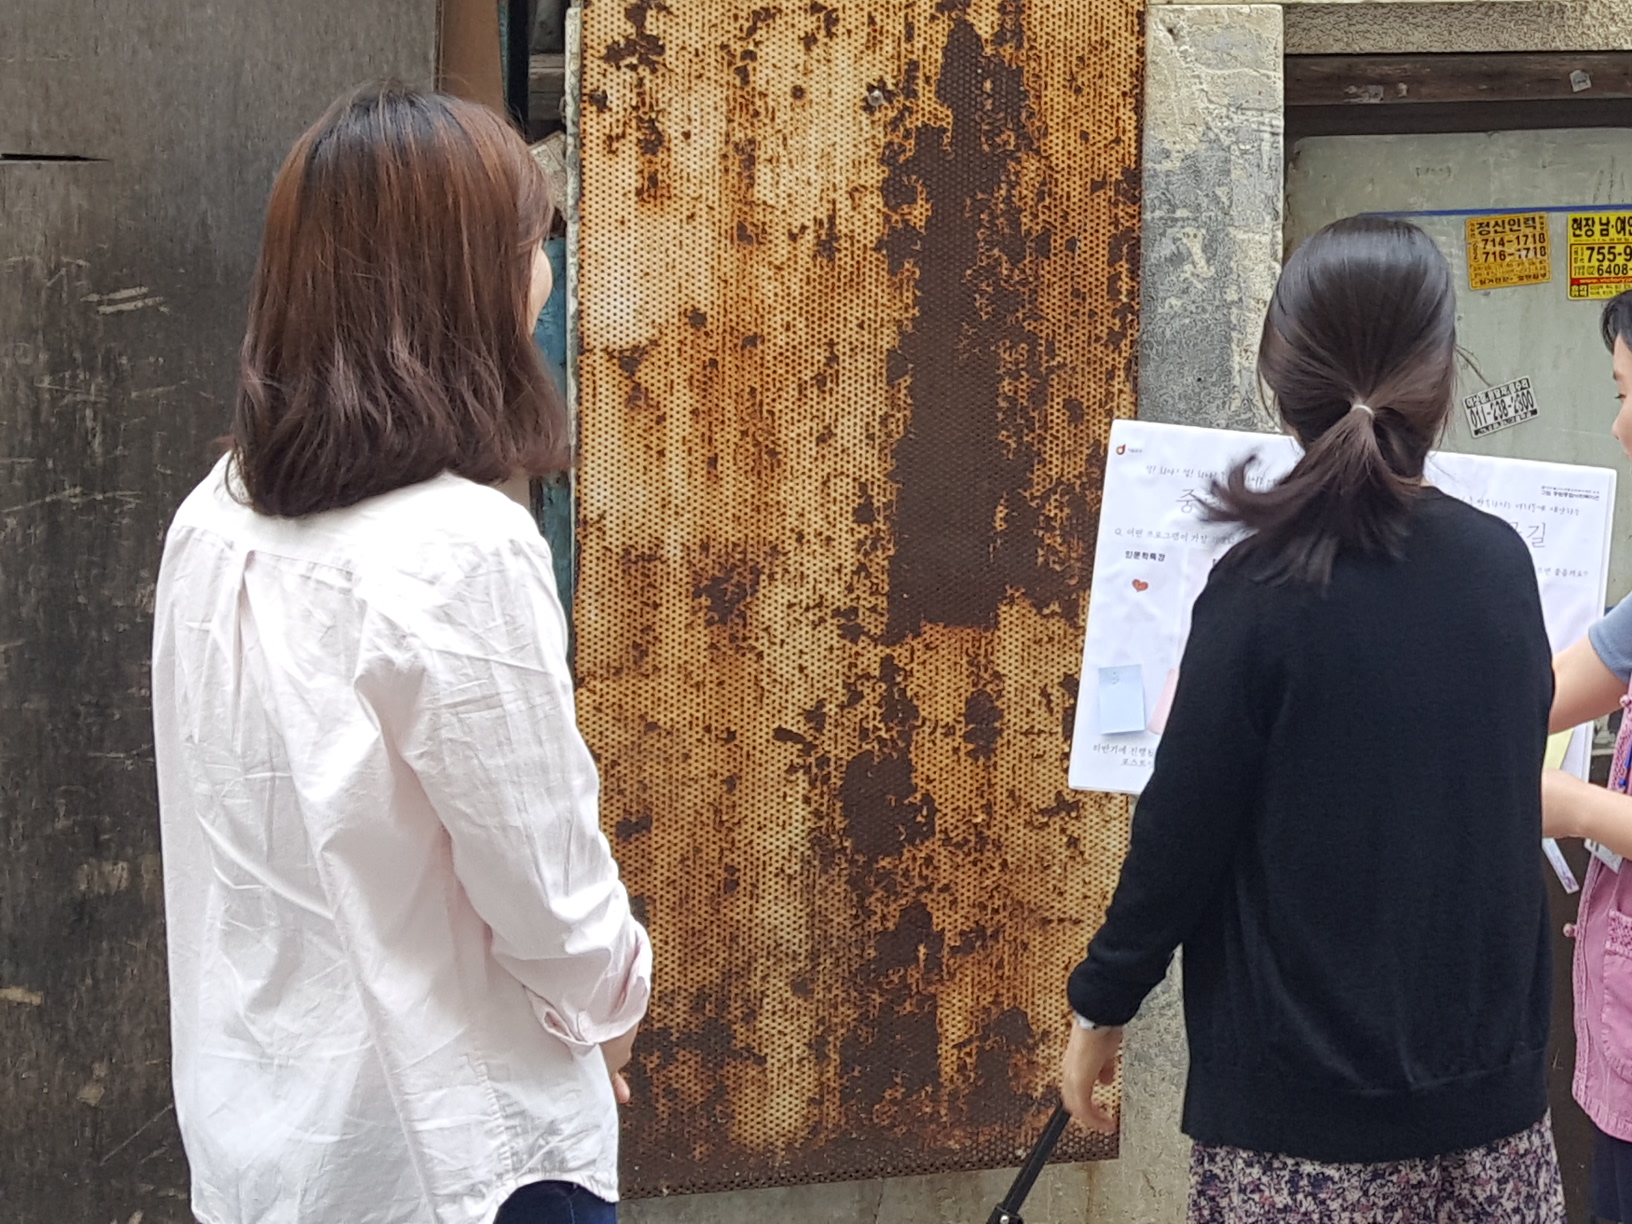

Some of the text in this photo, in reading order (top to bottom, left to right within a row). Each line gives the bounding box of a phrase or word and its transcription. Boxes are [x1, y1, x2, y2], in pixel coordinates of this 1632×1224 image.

[1476, 216, 1537, 236] 정신인력
[1571, 217, 1596, 238] 현장
[1480, 232, 1546, 250] 714-1718
[1482, 245, 1547, 263] 716-1718
